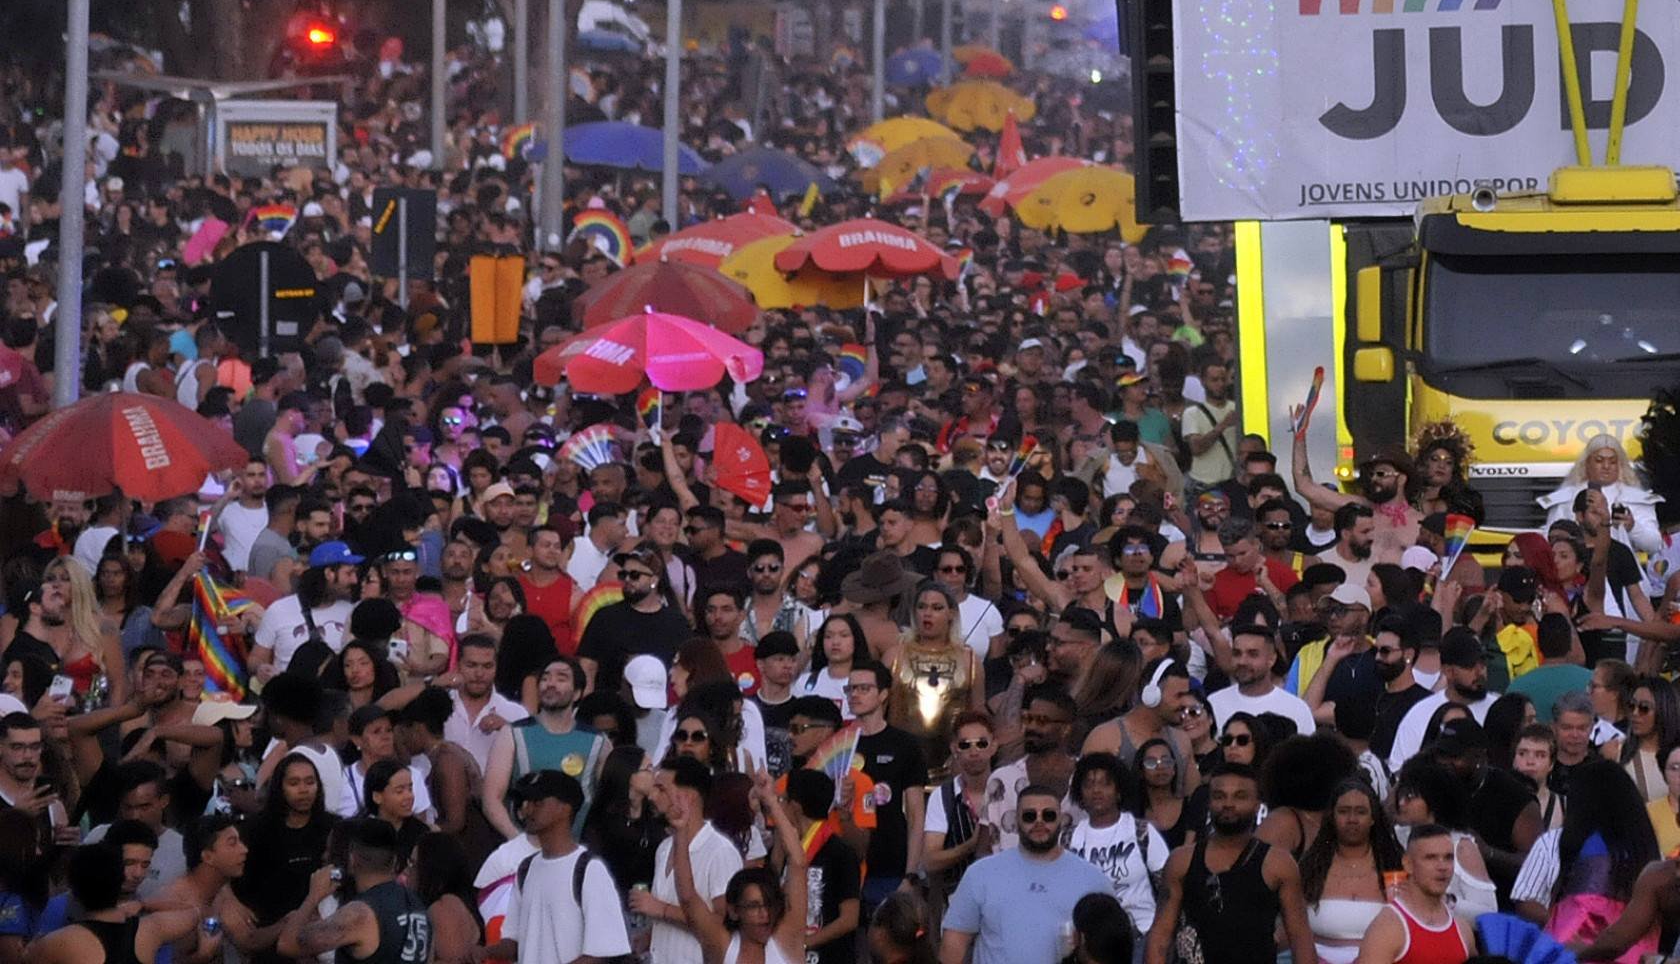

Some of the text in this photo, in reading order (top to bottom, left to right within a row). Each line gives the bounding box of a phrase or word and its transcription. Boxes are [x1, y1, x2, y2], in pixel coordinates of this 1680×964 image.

[1300, 182, 1386, 207] JOVENS
[1493, 177, 1539, 193] POR
[839, 230, 917, 252] BRAHMA
[122, 405, 170, 471] BRAHMA
[1471, 466, 1529, 476] VOLVO
